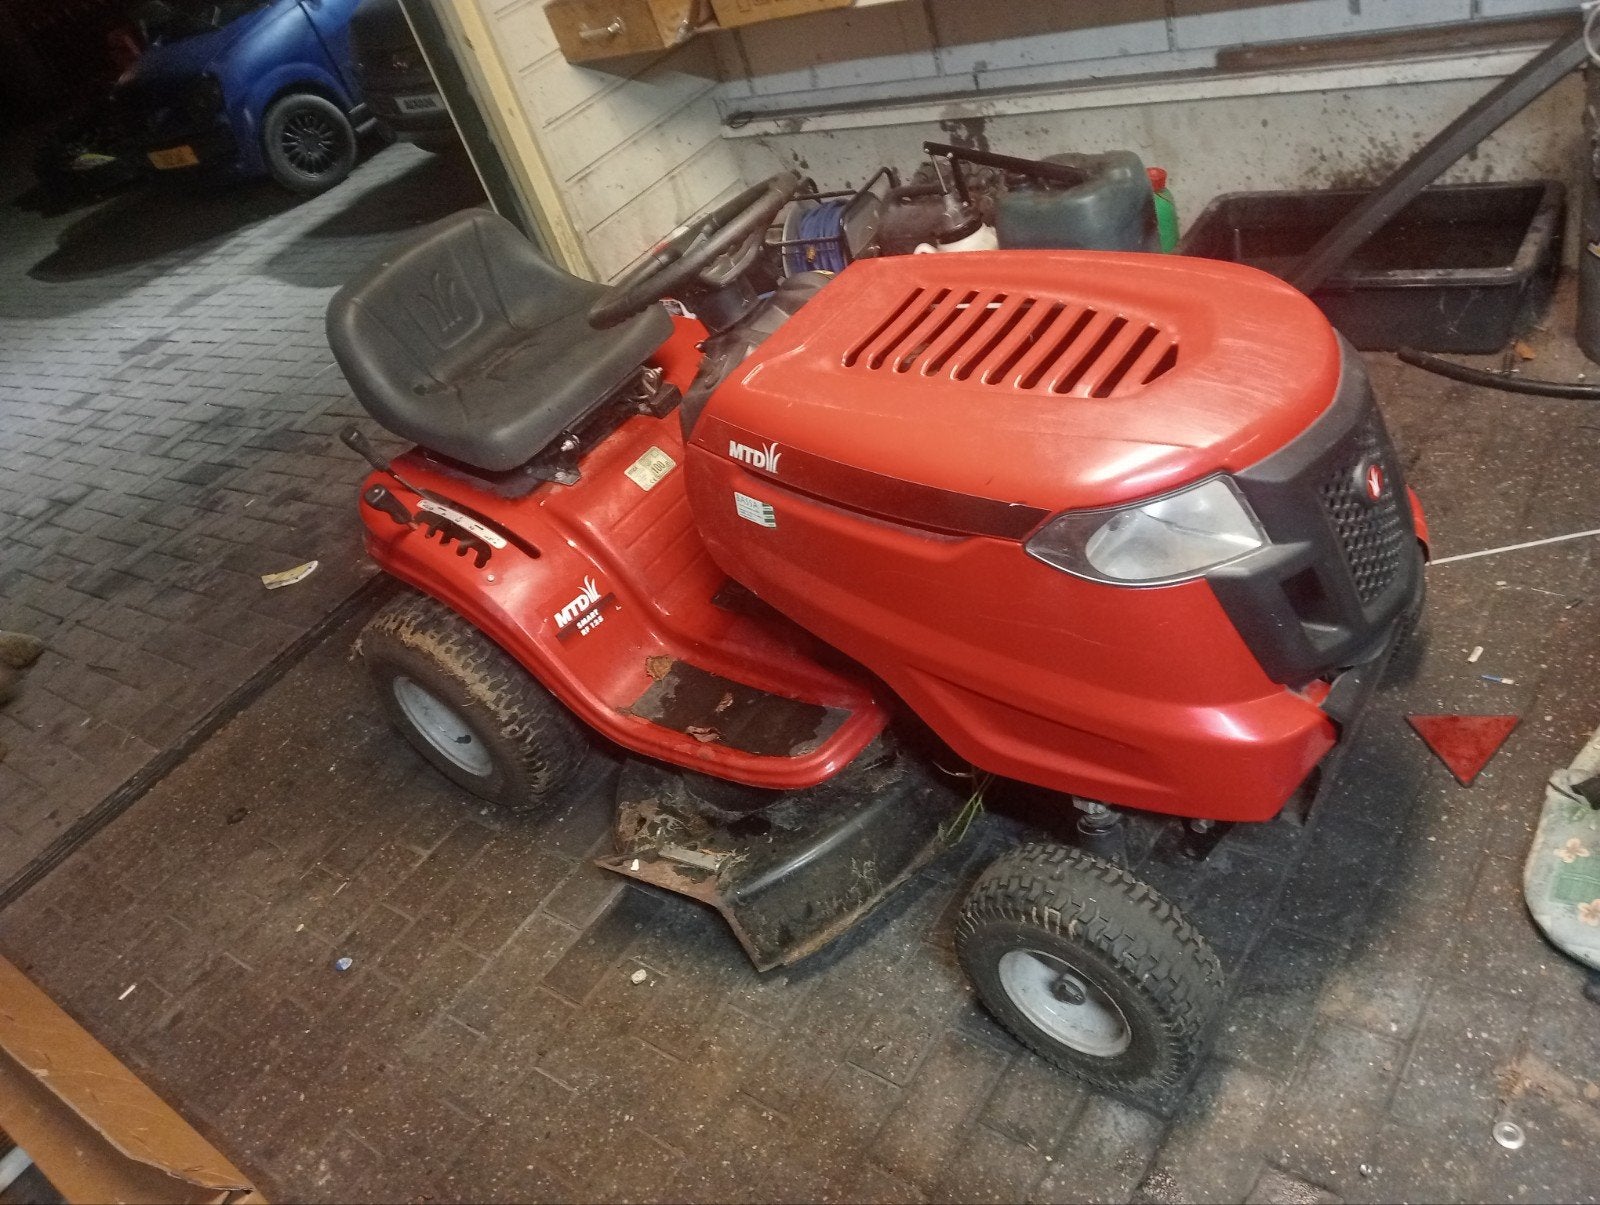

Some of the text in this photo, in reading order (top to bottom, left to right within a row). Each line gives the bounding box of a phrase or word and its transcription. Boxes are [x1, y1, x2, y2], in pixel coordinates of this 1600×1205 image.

[728, 440, 766, 468] MTD
[554, 594, 590, 628] MTD
[576, 609, 599, 629] SMART
